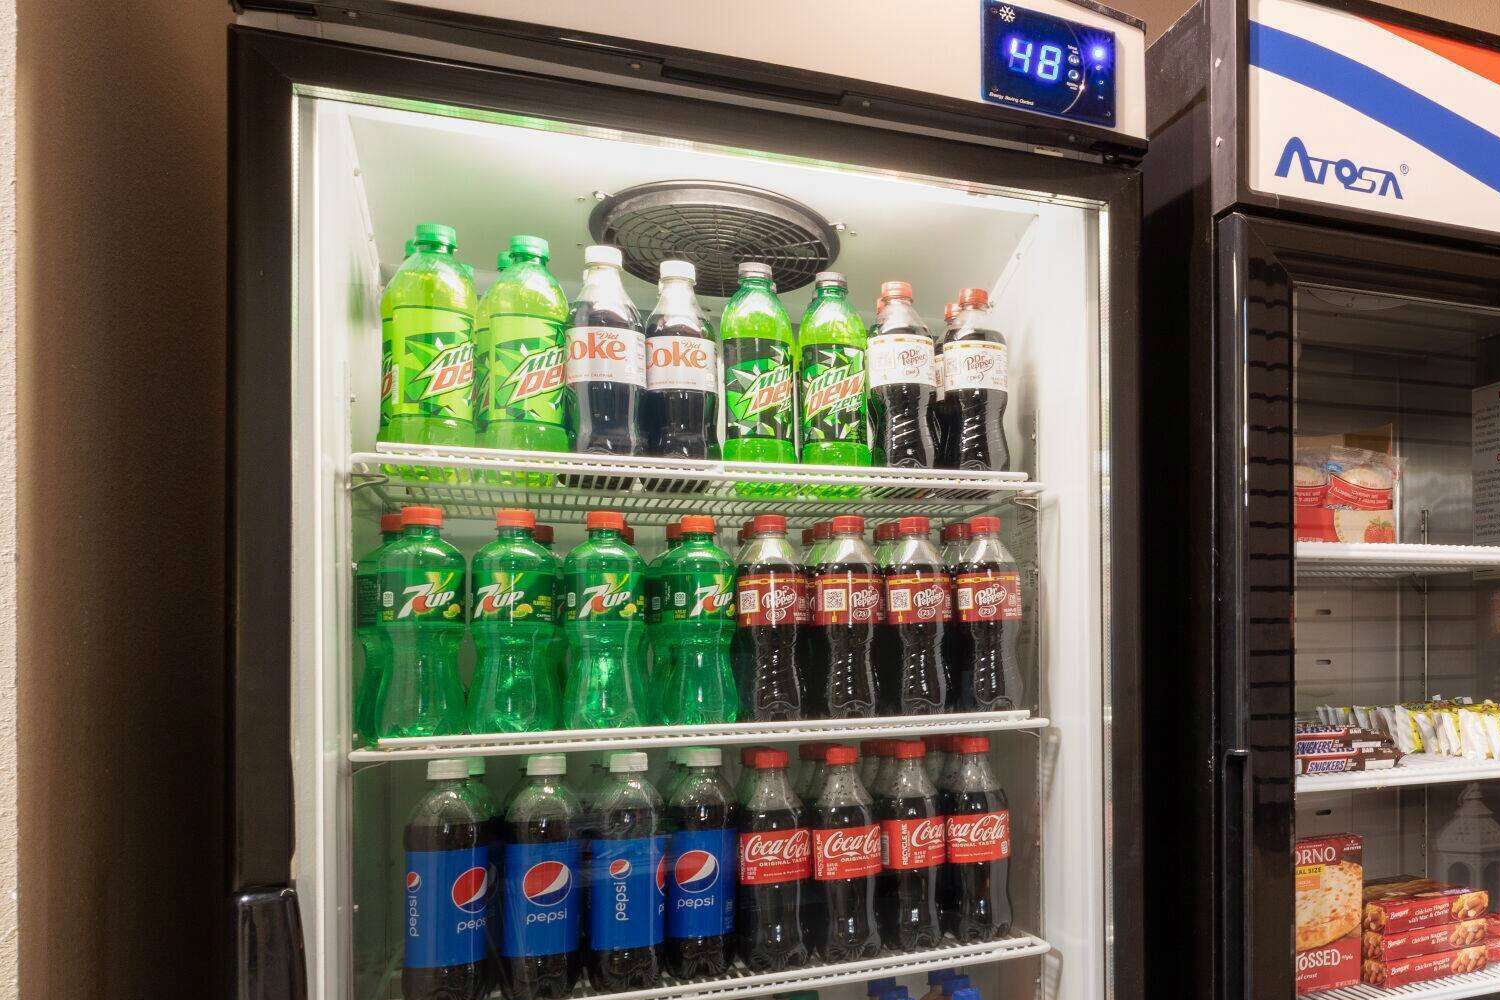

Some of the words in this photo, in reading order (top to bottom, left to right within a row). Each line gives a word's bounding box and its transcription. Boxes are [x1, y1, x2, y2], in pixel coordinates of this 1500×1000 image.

[1008, 37, 1062, 81] 48
[274, 136, 404, 200] ATOSA
[853, 592, 878, 609] Pepper
[917, 591, 943, 608] Pepper
[978, 590, 1005, 606] Pepper
[1308, 760, 1345, 772] SNICKERS
[901, 823, 908, 834] ME
[901, 835, 909, 865] RECYCLE
[759, 859, 790, 868] ORIGINAL
[840, 855, 869, 863] ORIGINAL
[615, 881, 629, 921] pepsi
[677, 894, 715, 909] pepsi
[408, 895, 420, 937] pepsi
[526, 908, 568, 926] pepsi
[457, 916, 487, 934] peps
